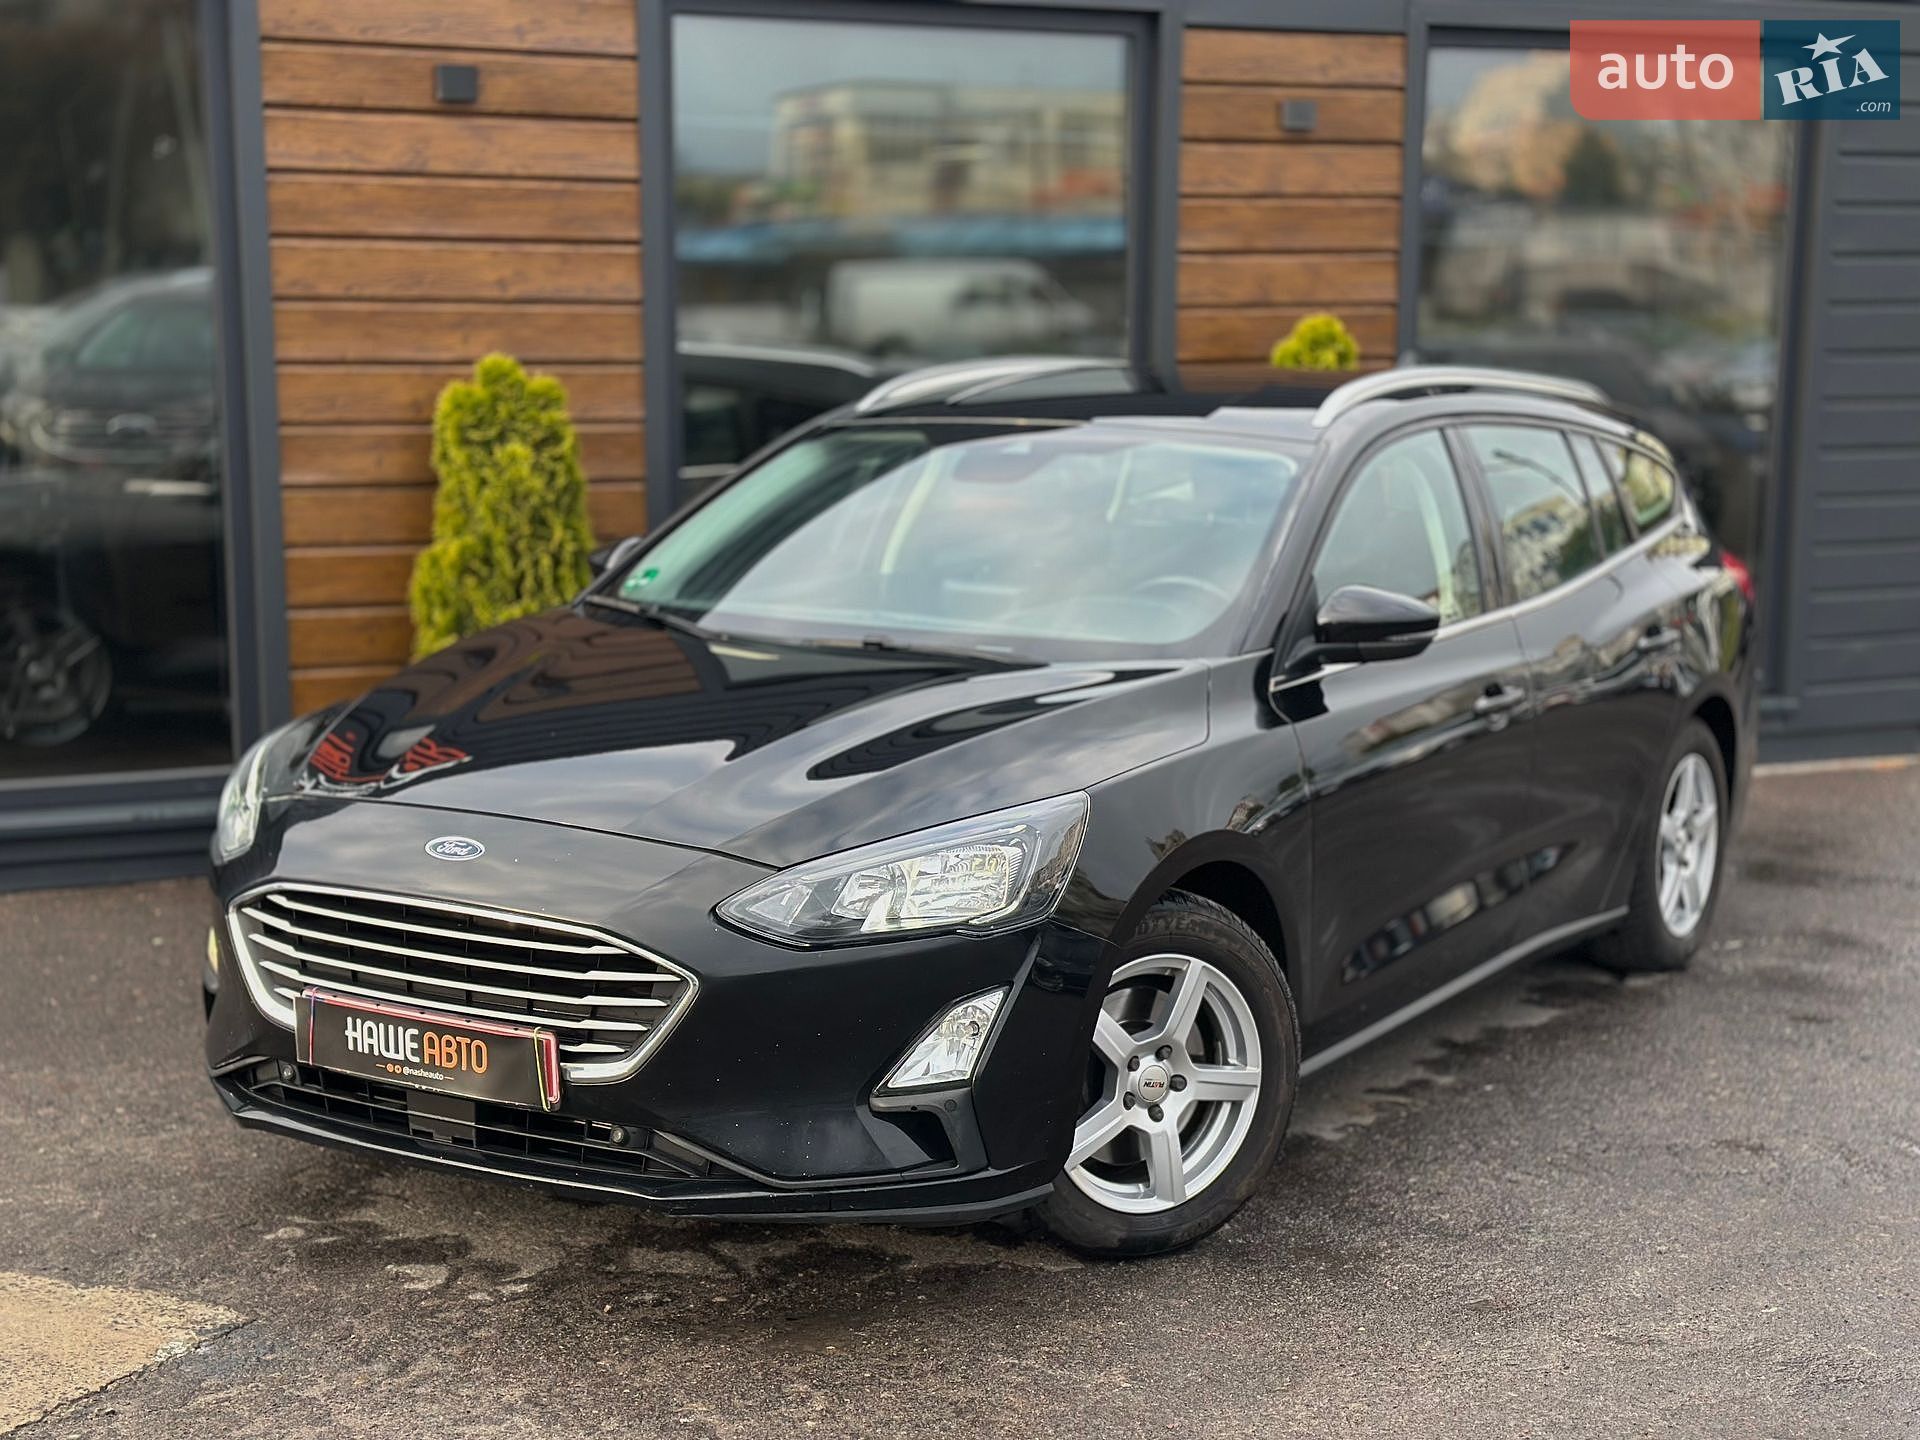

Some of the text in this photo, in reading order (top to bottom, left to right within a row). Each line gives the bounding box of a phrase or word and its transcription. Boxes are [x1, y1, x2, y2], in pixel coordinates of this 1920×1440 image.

[436, 841, 473, 856] Ford
[345, 1016, 488, 1074] НАШЕ АВТО
[402, 1066, 444, 1081] @nasheauto
